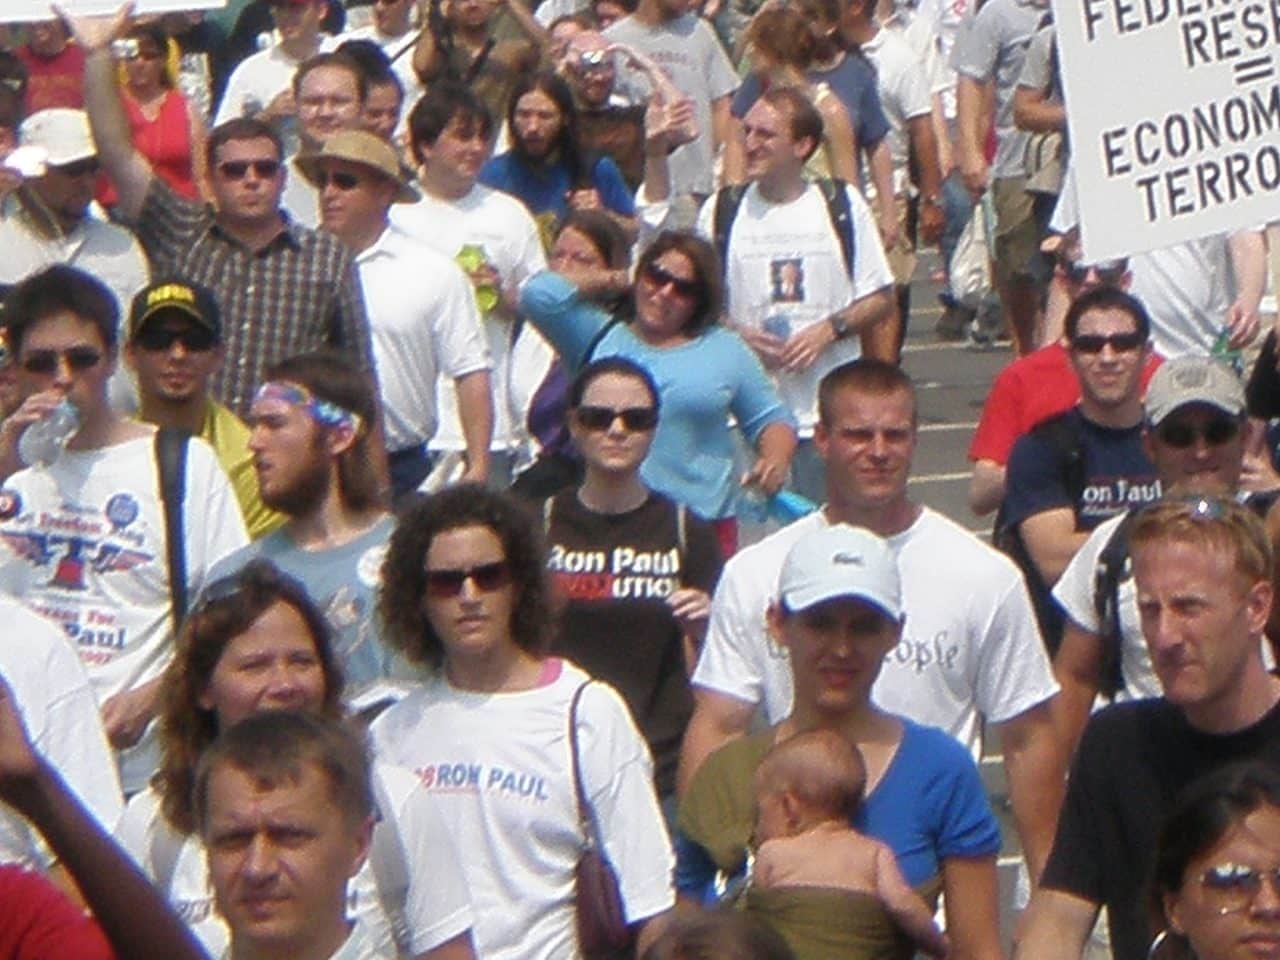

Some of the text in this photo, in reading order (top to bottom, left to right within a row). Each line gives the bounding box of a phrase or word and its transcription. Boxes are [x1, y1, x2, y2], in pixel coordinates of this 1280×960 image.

[1082, 486, 1113, 503] on
[547, 544, 681, 575] Ron Paul
[488, 767, 550, 801] PAUL
